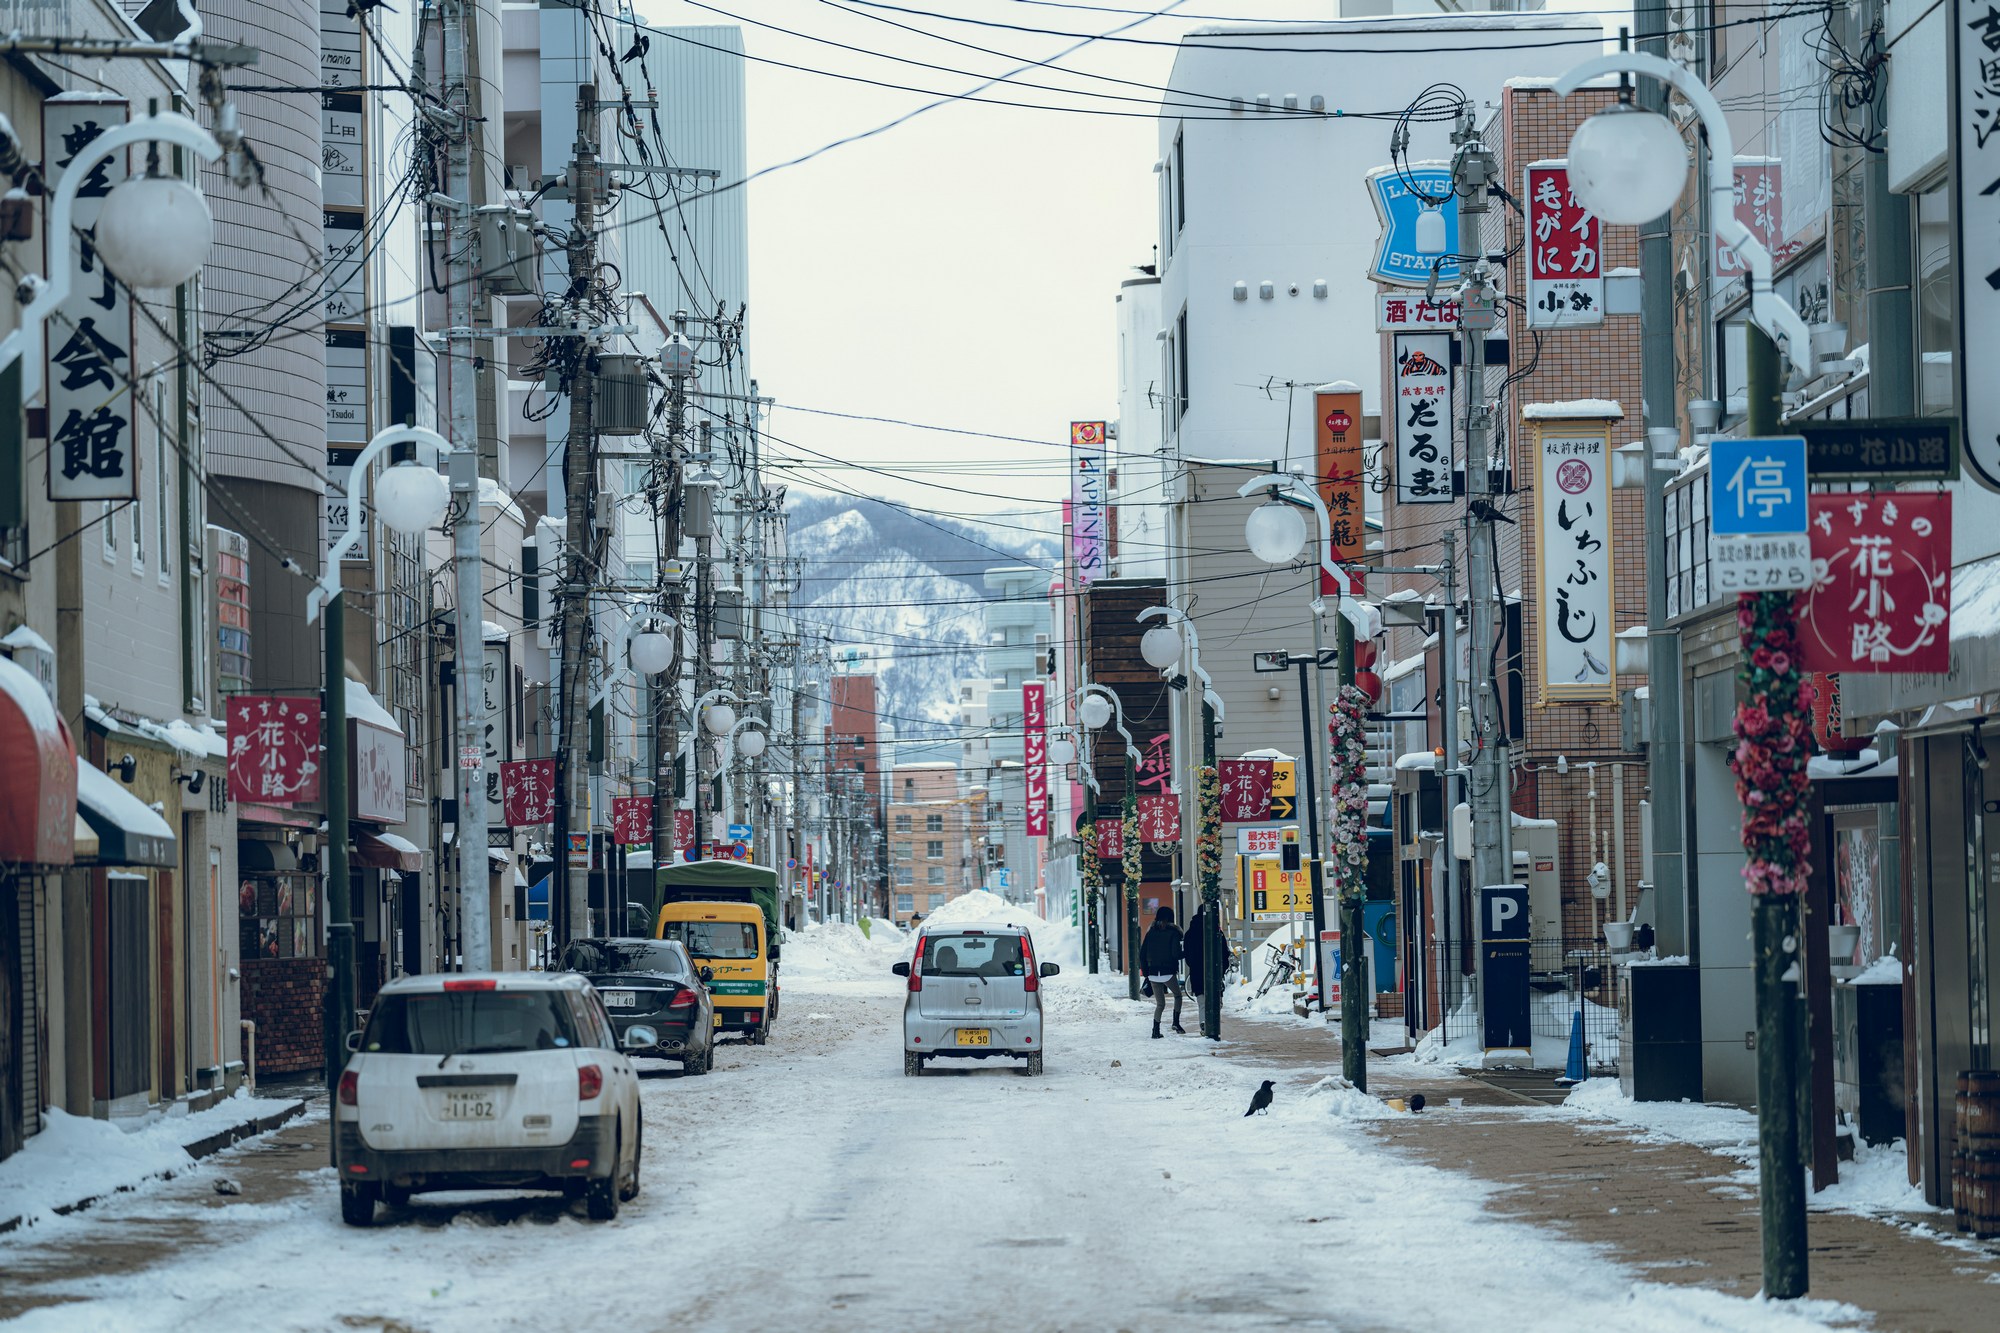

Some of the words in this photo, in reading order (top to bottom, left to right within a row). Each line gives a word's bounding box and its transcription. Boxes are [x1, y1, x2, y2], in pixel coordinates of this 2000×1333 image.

[323, 116, 355, 137] 上田
[1534, 176, 1563, 274] 毛がに
[330, 409, 354, 419] Tsudoi
[1406, 397, 1439, 497] だるま
[1546, 442, 1600, 455] 板前料理
[1726, 455, 1792, 520] 停
[1079, 455, 1101, 570] HAPPINESS
[1813, 500, 1933, 537] すすきの
[1556, 499, 1602, 643] いちふじ
[1721, 567, 1806, 588] ここから
[1849, 534, 1896, 662] 花小路
[259, 721, 287, 797] 花小路
[521, 776, 540, 821] 花小路
[1237, 774, 1253, 819] 花小路
[627, 808, 640, 841] 花小路
[1152, 806, 1165, 839] 花小路
[1248, 831, 1280, 841] 最大料
[1107, 828, 1118, 856] 花小路
[1491, 897, 1519, 932] P
[370, 1123, 394, 1132] AD
